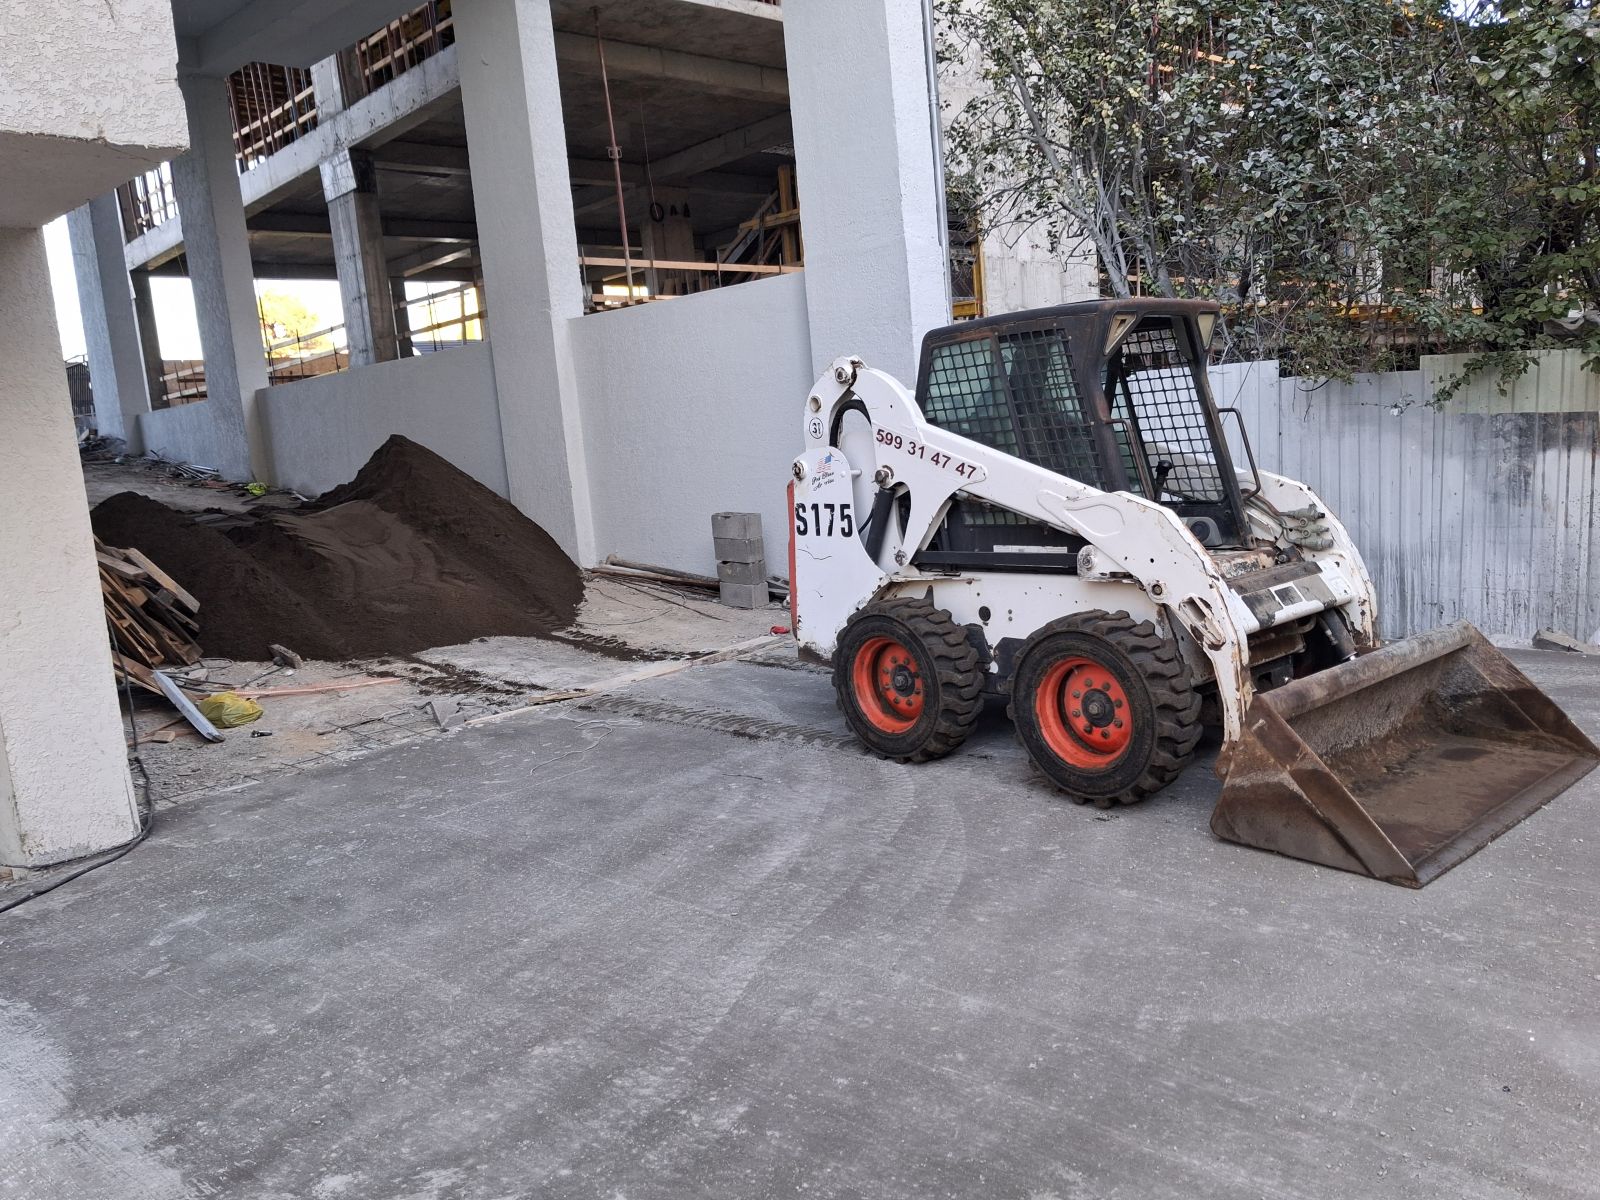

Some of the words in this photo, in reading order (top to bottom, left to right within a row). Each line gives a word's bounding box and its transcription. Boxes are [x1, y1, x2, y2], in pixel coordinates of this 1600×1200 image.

[876, 428, 903, 449] 599
[907, 441, 925, 459] 31
[930, 452, 951, 469] 47
[955, 462, 977, 479] 47
[795, 503, 853, 537] S175
